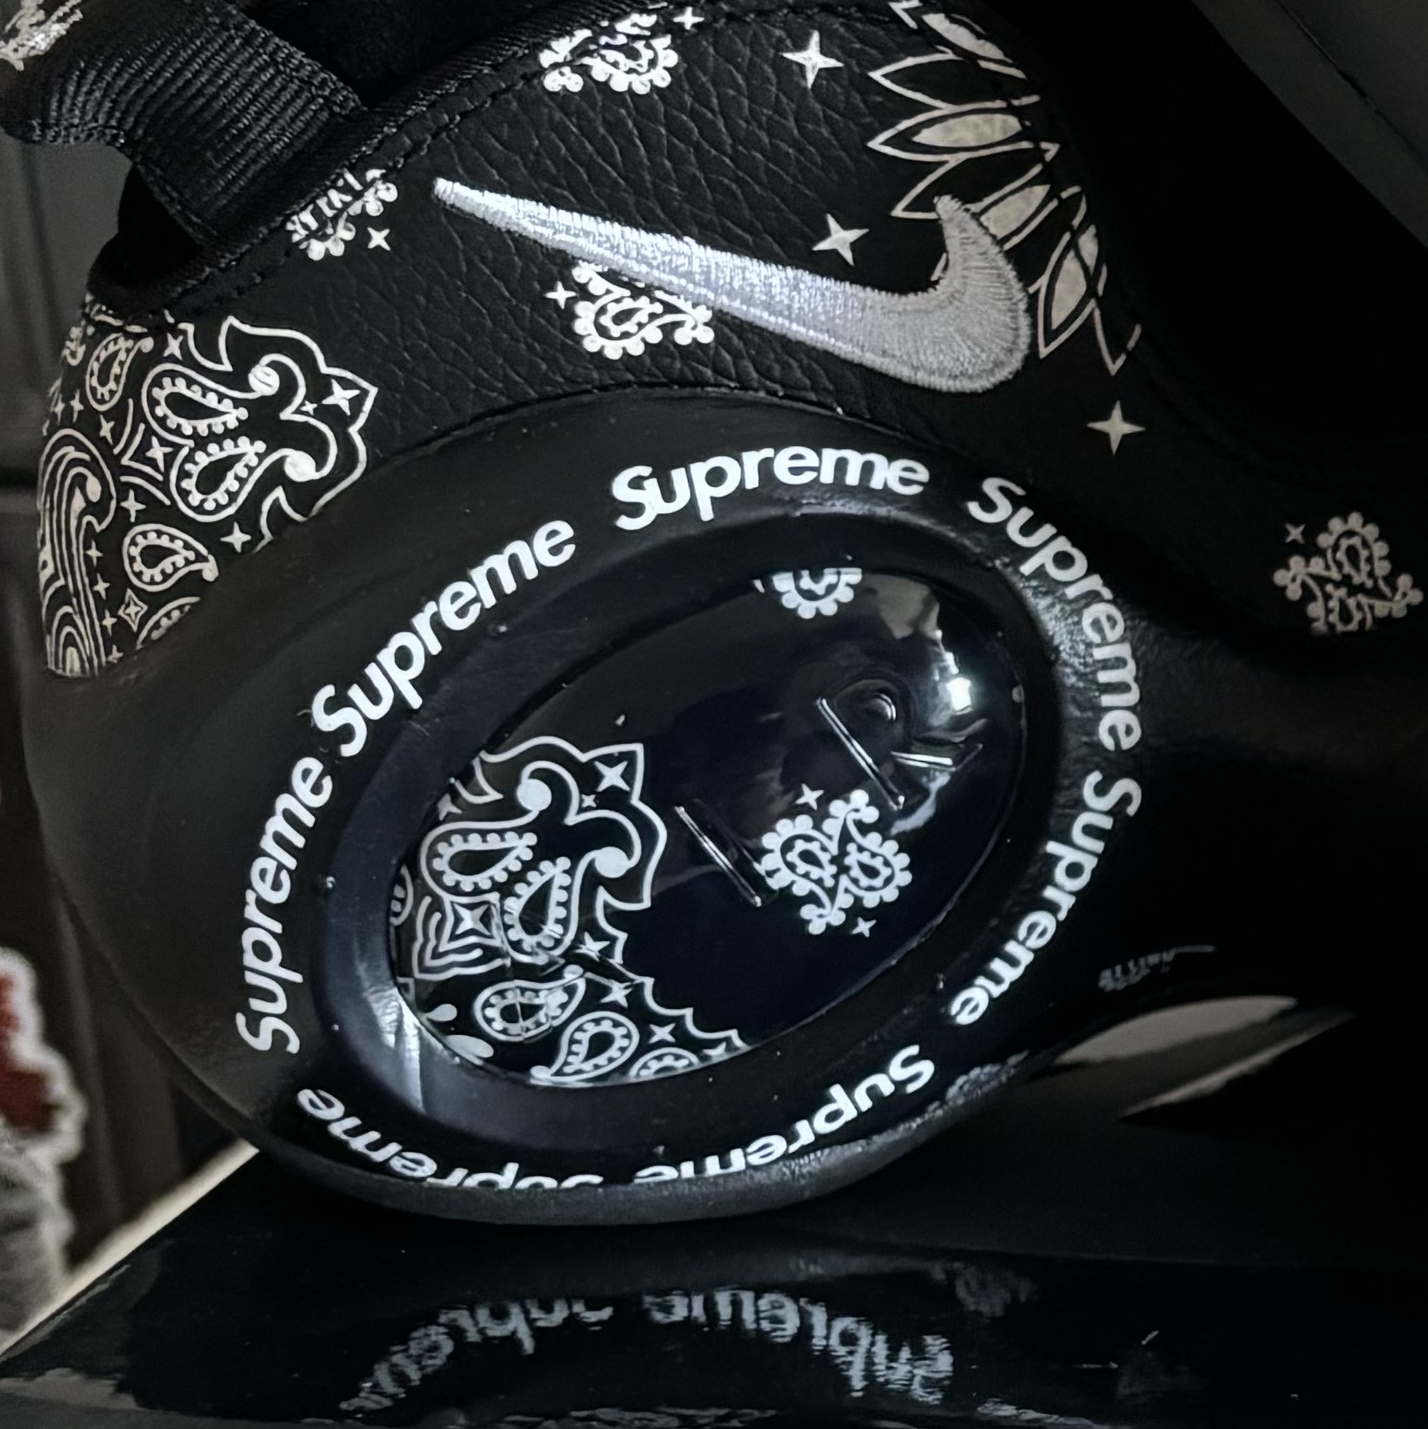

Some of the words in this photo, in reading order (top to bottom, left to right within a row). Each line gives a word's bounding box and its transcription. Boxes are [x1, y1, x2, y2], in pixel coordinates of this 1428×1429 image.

[610, 444, 930, 532] Supreme
[310, 519, 579, 758] Supreme
[965, 477, 1142, 752] Supreme
[236, 757, 334, 1055] Supreme
[949, 770, 1143, 1026] Supreme
[632, 1042, 936, 1185] Supreme
